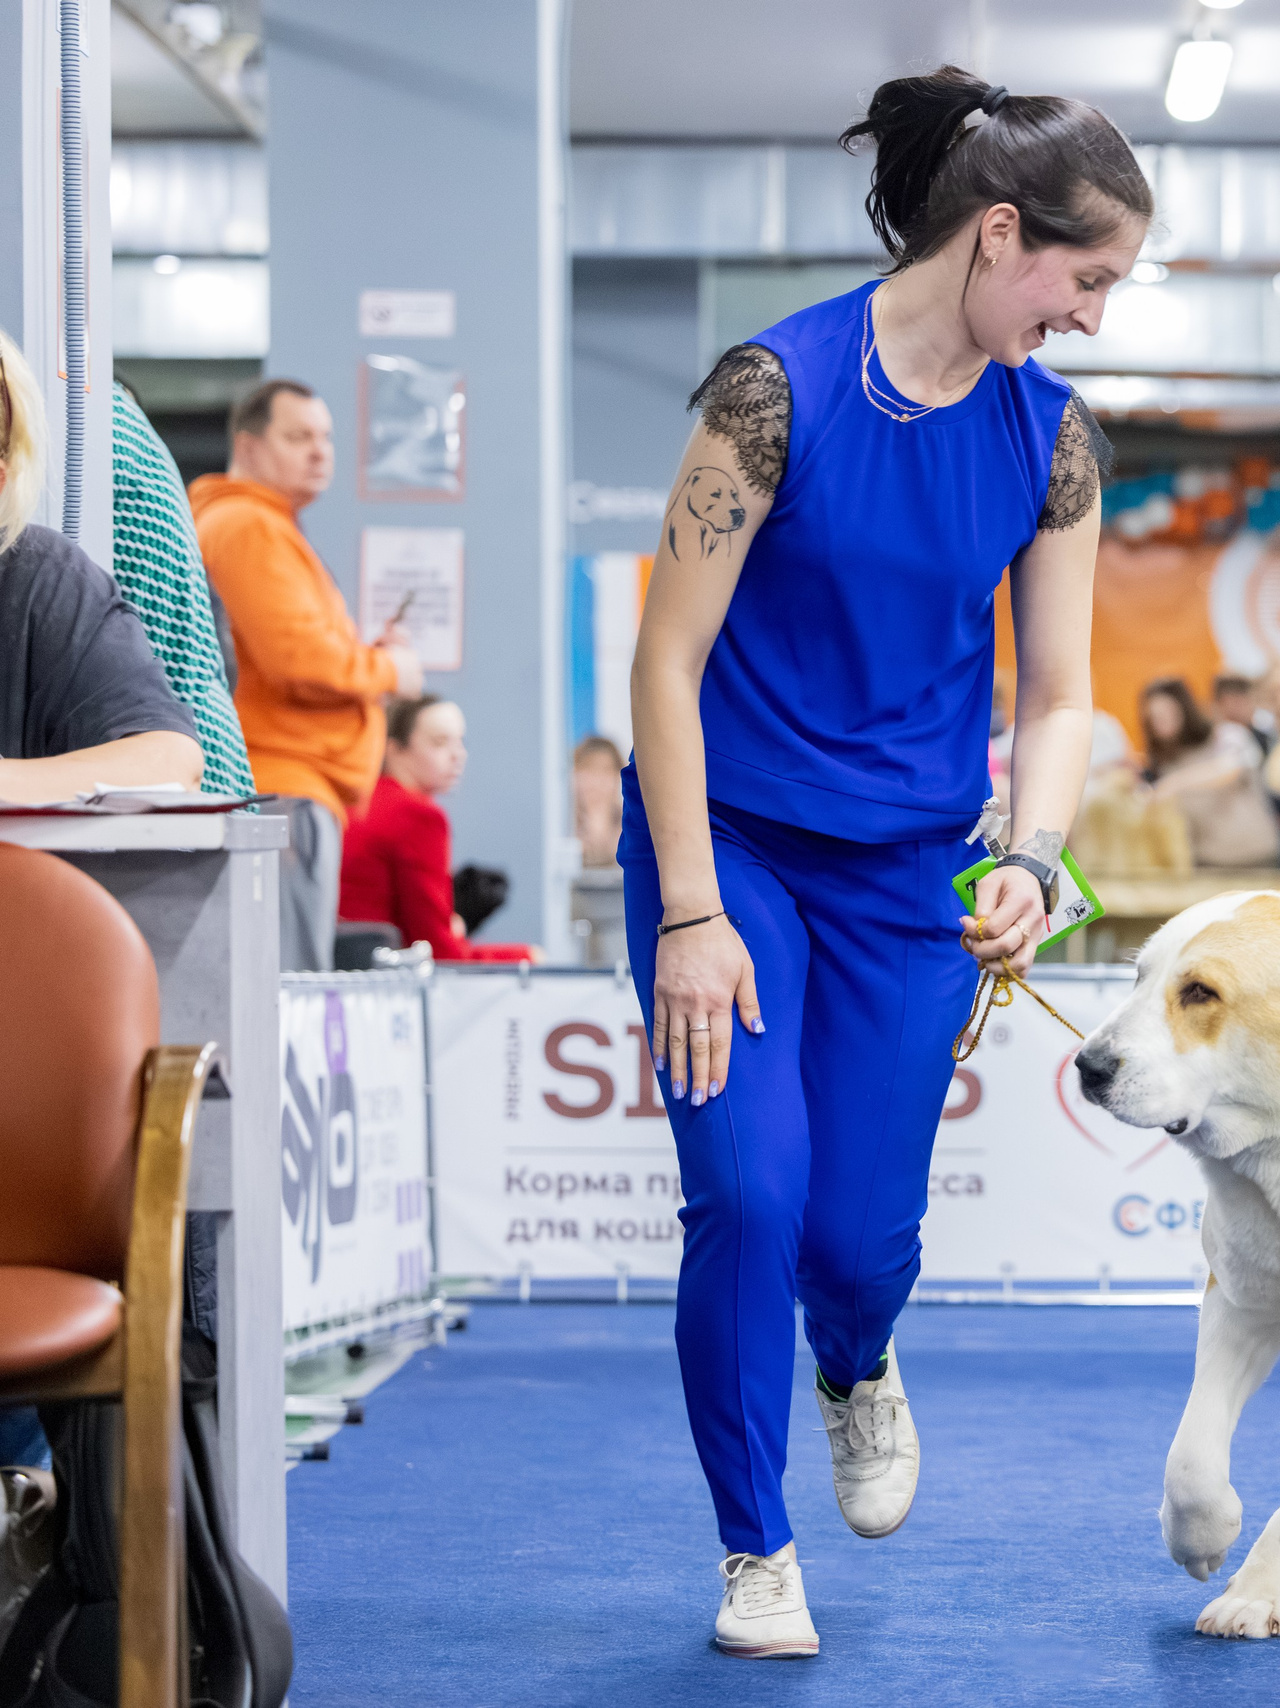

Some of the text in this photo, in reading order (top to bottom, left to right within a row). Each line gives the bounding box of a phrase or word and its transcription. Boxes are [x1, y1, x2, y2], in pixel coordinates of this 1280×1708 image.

[504, 1167, 632, 1202] Корма
[506, 1217, 685, 1244] для кош
